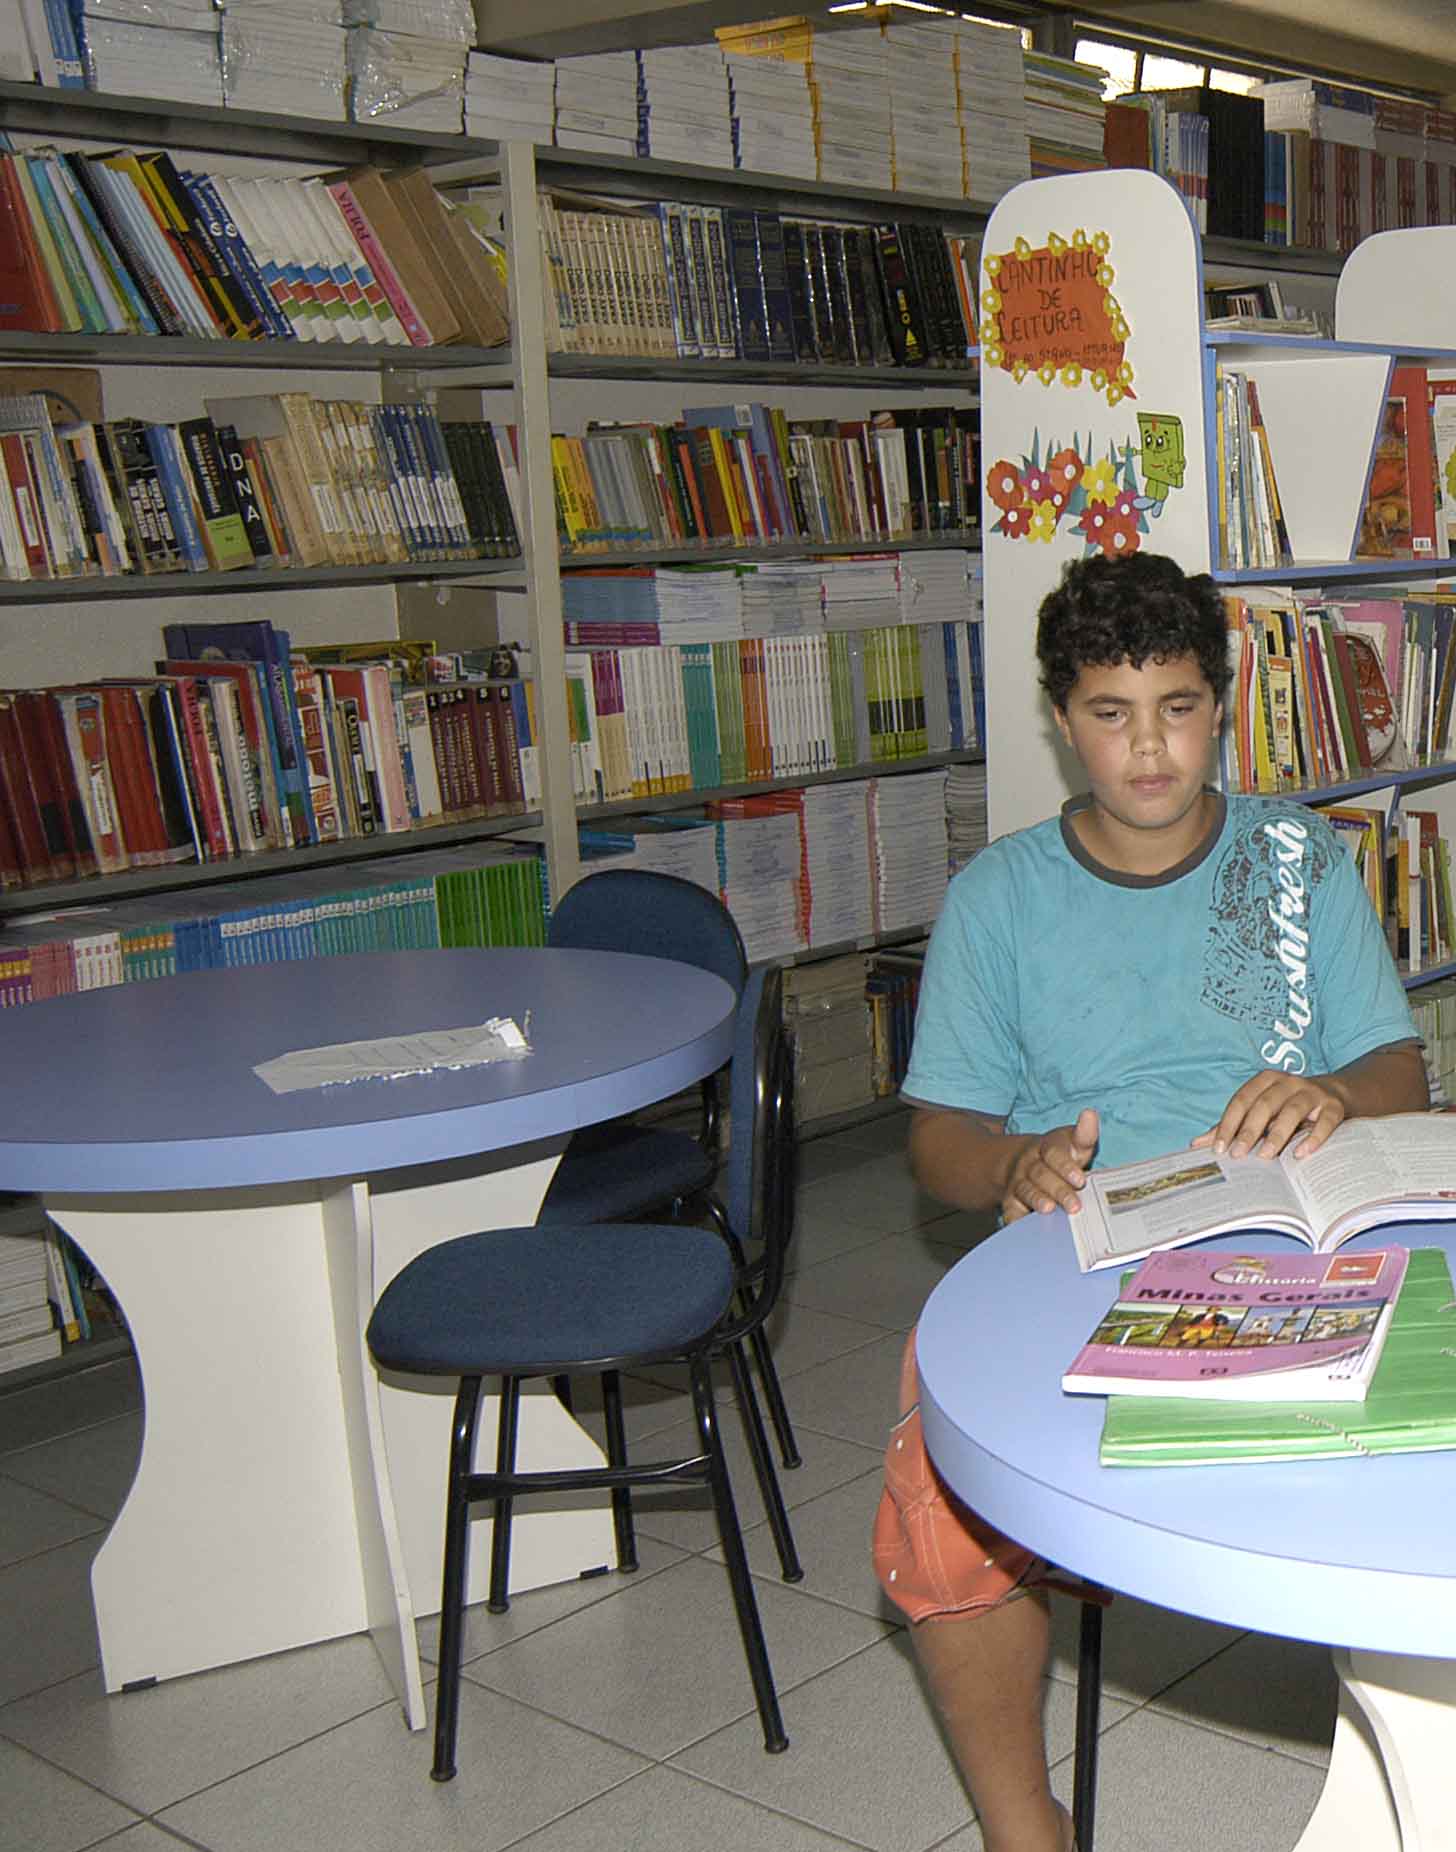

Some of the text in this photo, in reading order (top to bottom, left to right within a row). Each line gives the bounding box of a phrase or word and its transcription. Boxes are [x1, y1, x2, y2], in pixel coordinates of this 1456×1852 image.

[1037, 288, 1062, 310] DE
[1136, 1288, 1372, 1302] Minas Gerais
